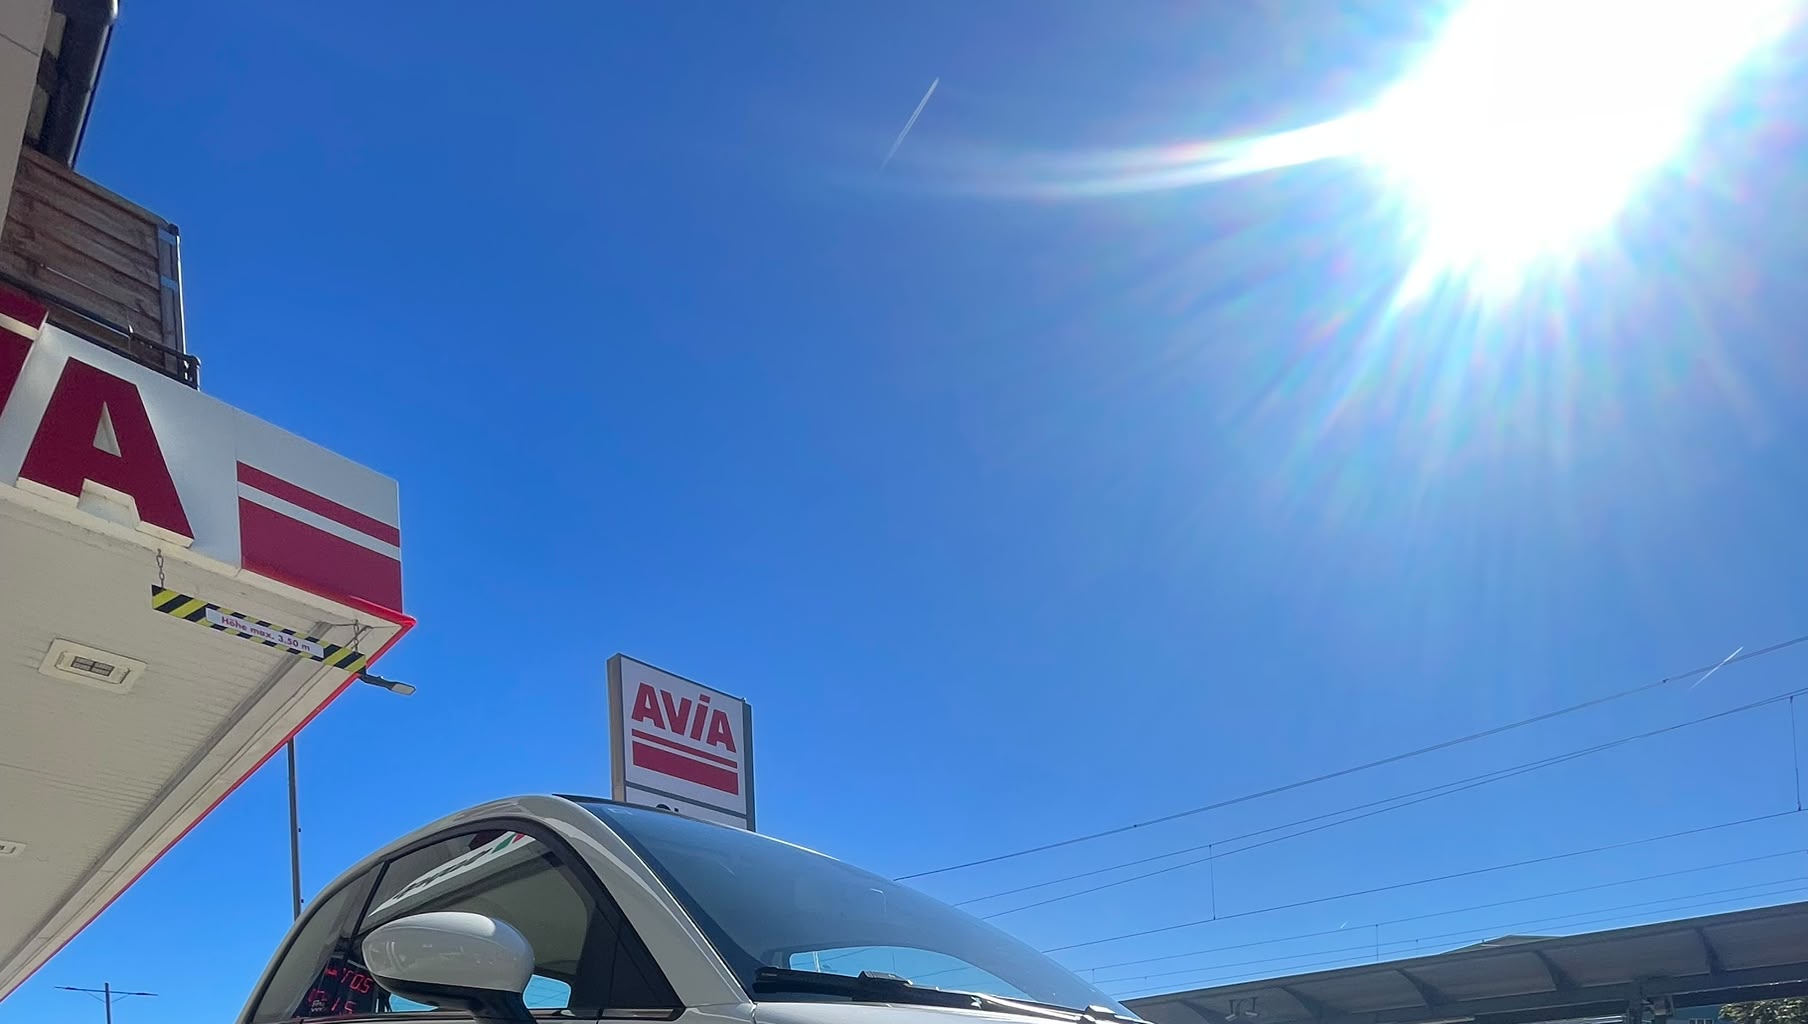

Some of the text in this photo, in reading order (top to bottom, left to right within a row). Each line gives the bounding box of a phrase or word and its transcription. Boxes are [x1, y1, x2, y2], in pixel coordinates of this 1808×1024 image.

[221, 616, 310, 652] Höhe max. 3.50 m
